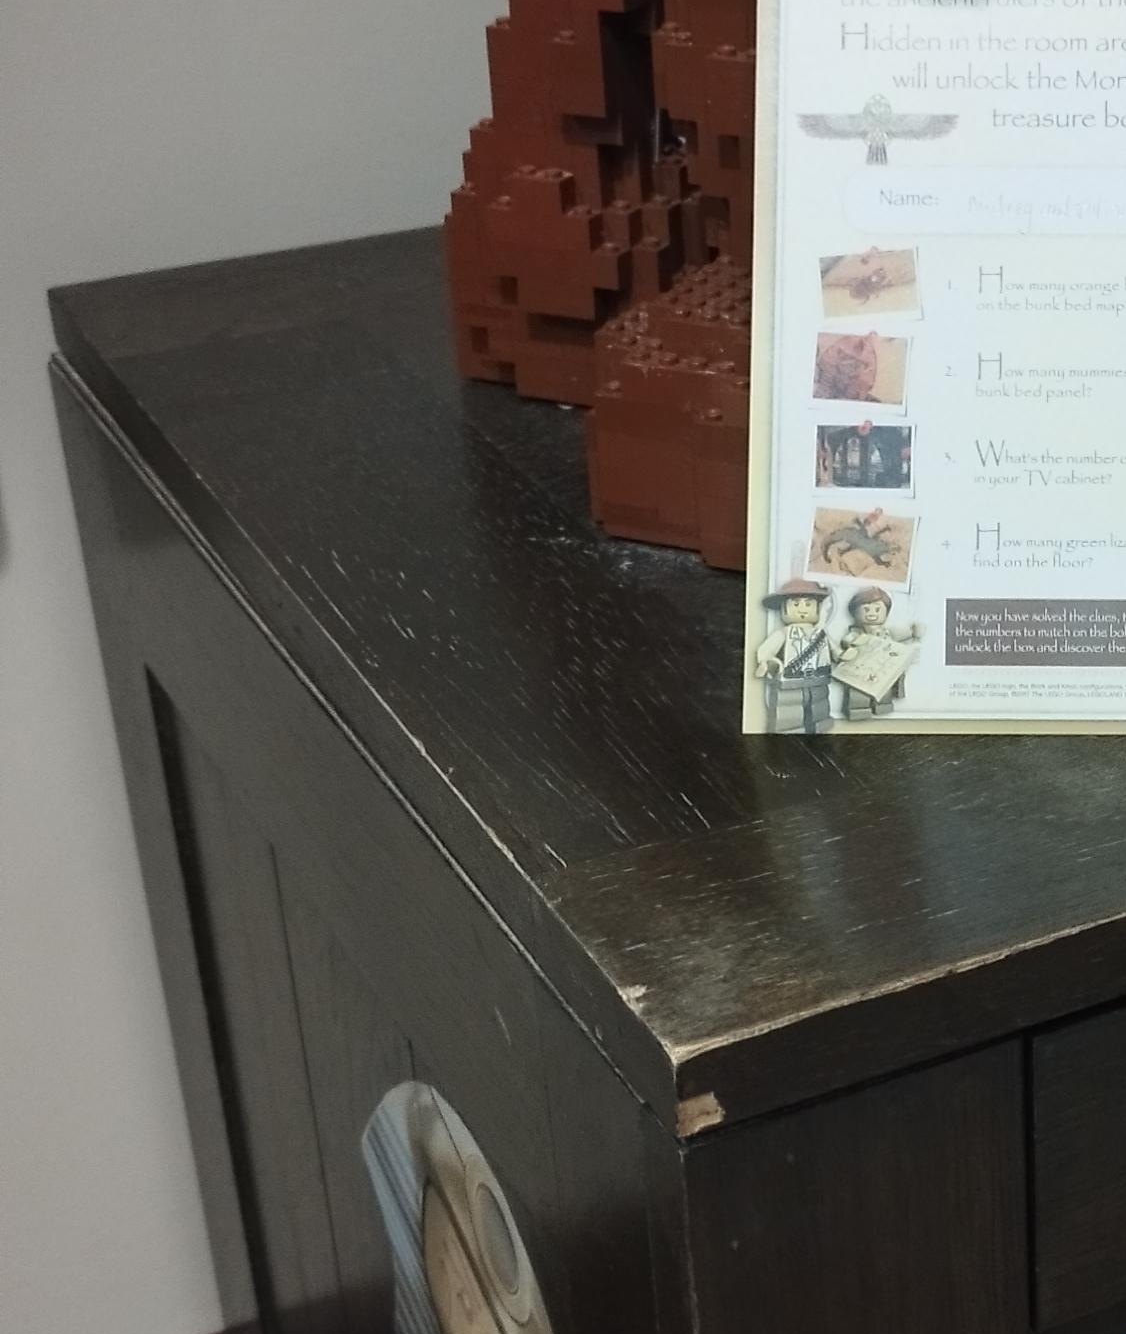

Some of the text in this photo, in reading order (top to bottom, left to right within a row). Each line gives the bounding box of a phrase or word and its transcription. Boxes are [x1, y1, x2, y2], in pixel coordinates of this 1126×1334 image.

[840, 21, 941, 51] Hidden
[950, 34, 969, 51] in
[977, 21, 1017, 51] the
[1024, 34, 1088, 51] room
[892, 61, 928, 90] will
[935, 61, 1019, 90] unlock
[1026, 61, 1067, 90] the
[991, 107, 1097, 129] treasure
[879, 188, 940, 208] Name:
[977, 265, 1024, 294] How
[1029, 280, 1065, 299] many
[1069, 280, 1119, 296] orange
[999, 296, 1092, 312] the bunk bed
[976, 351, 1023, 380] How
[1028, 367, 1065, 383] many
[975, 382, 1093, 404] bunk bed panel?
[974, 439, 1037, 468] What's
[1041, 448, 1062, 465] the
[1066, 448, 1117, 465] number
[989, 469, 1112, 489] your TV cabinet?
[975, 522, 1022, 551] How
[1026, 538, 1061, 555] many
[1065, 538, 1107, 553] green
[972, 551, 1094, 568] find the floor?
[955, 607, 1119, 626] Now you have solved the clues,
[955, 624, 1020, 638] the numbers
[954, 638, 1125, 653] unlock the box and discover the
